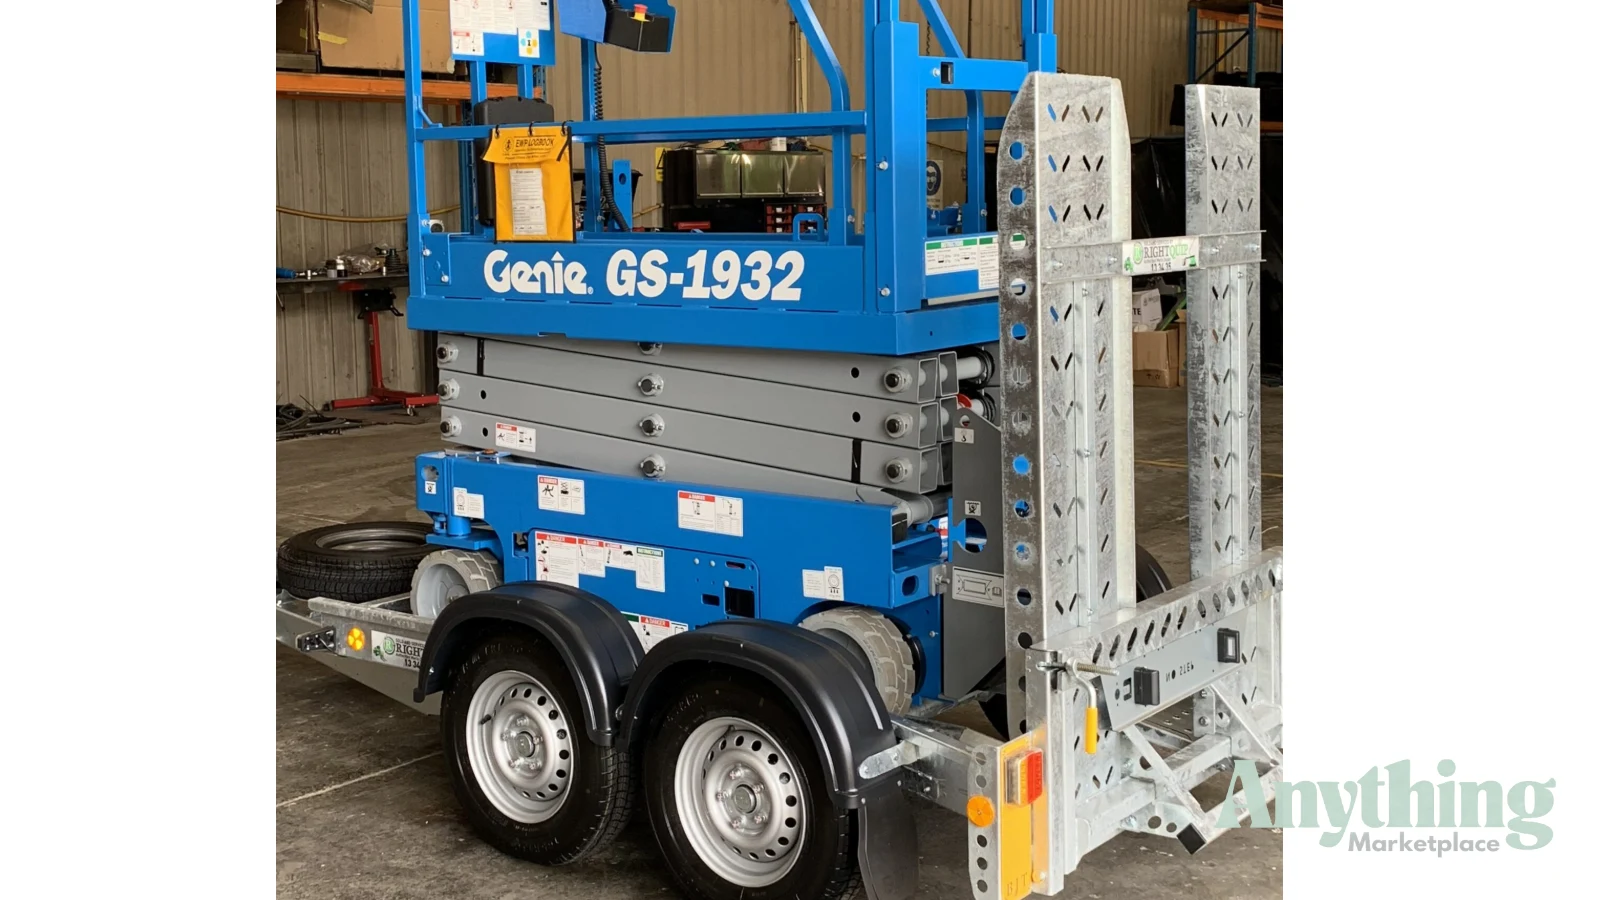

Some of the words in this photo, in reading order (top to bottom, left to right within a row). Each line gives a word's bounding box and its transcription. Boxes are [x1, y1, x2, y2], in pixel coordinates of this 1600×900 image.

[1144, 244, 1188, 259] RIGHTQUIP
[606, 249, 805, 301] GS-1932
[1132, 307, 1142, 316] TE
[404, 658, 412, 667] 13
